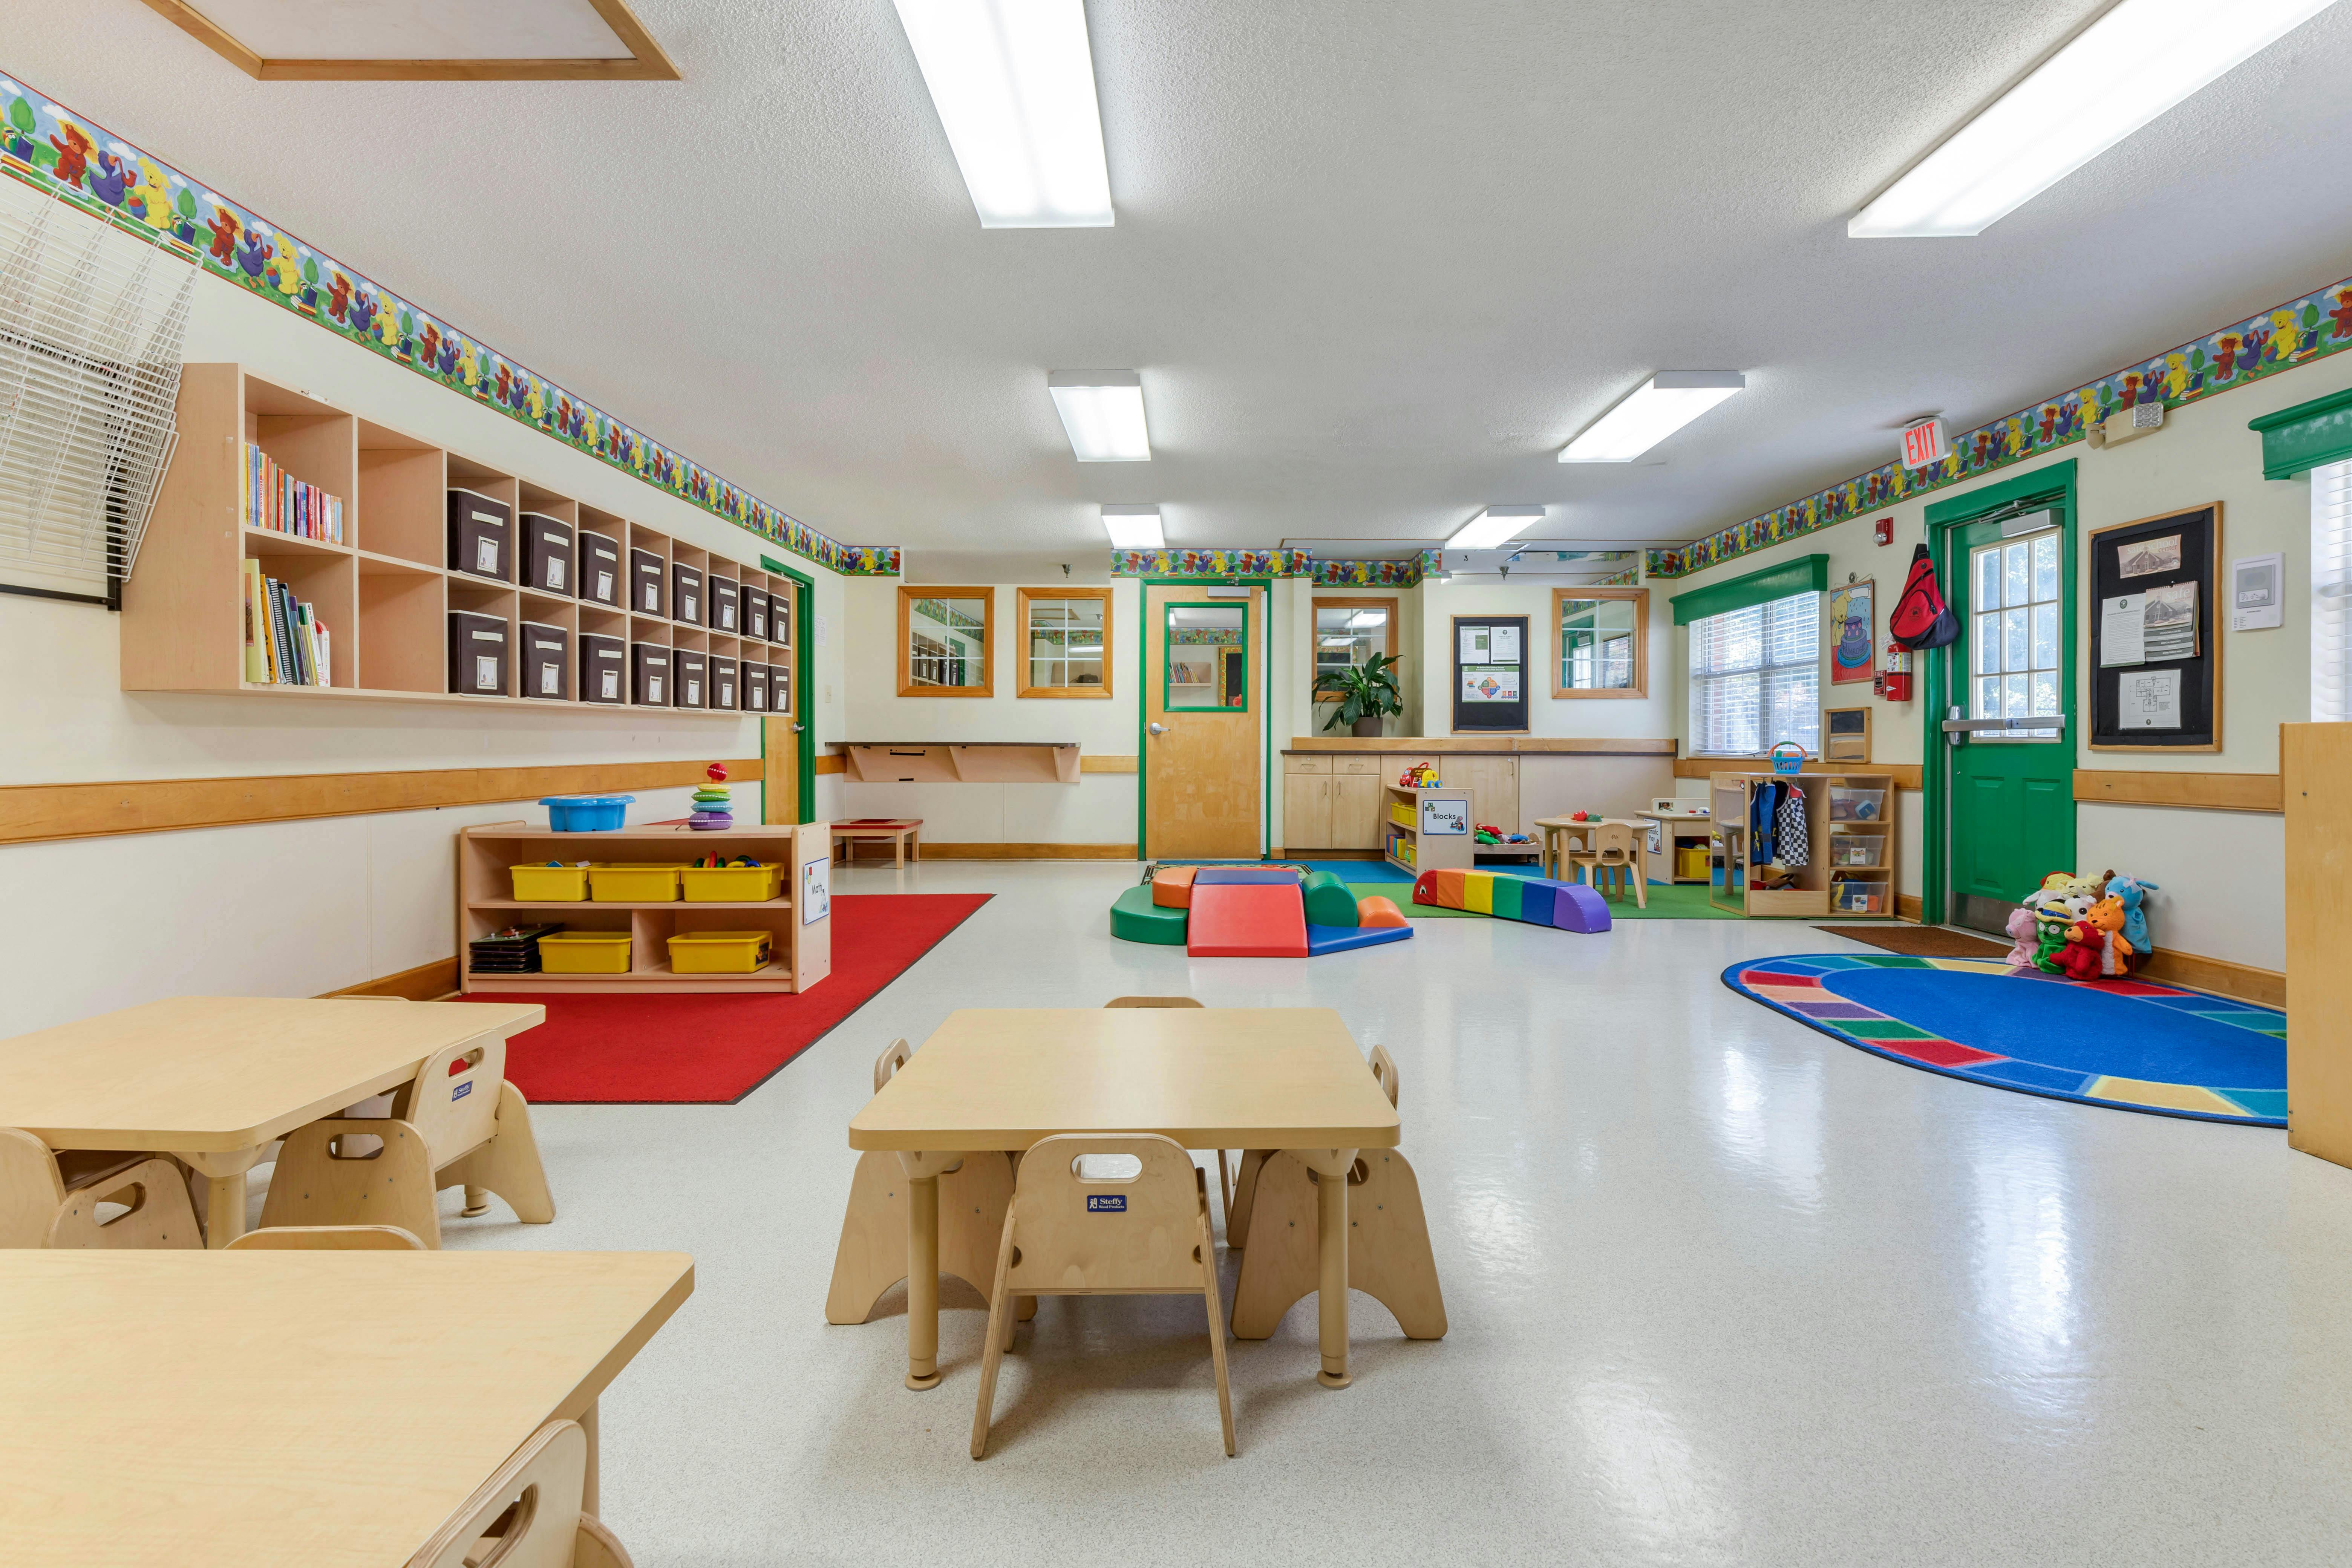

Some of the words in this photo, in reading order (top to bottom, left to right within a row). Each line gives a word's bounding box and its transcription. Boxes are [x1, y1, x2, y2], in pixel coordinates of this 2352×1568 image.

[1905, 422, 1936, 465] EXIT
[2127, 543, 2144, 554] safe
[2147, 536, 2177, 550] school
[2166, 586, 2190, 600] safe
[812, 882, 822, 895] Math
[458, 1084, 470, 1093] Steffy
